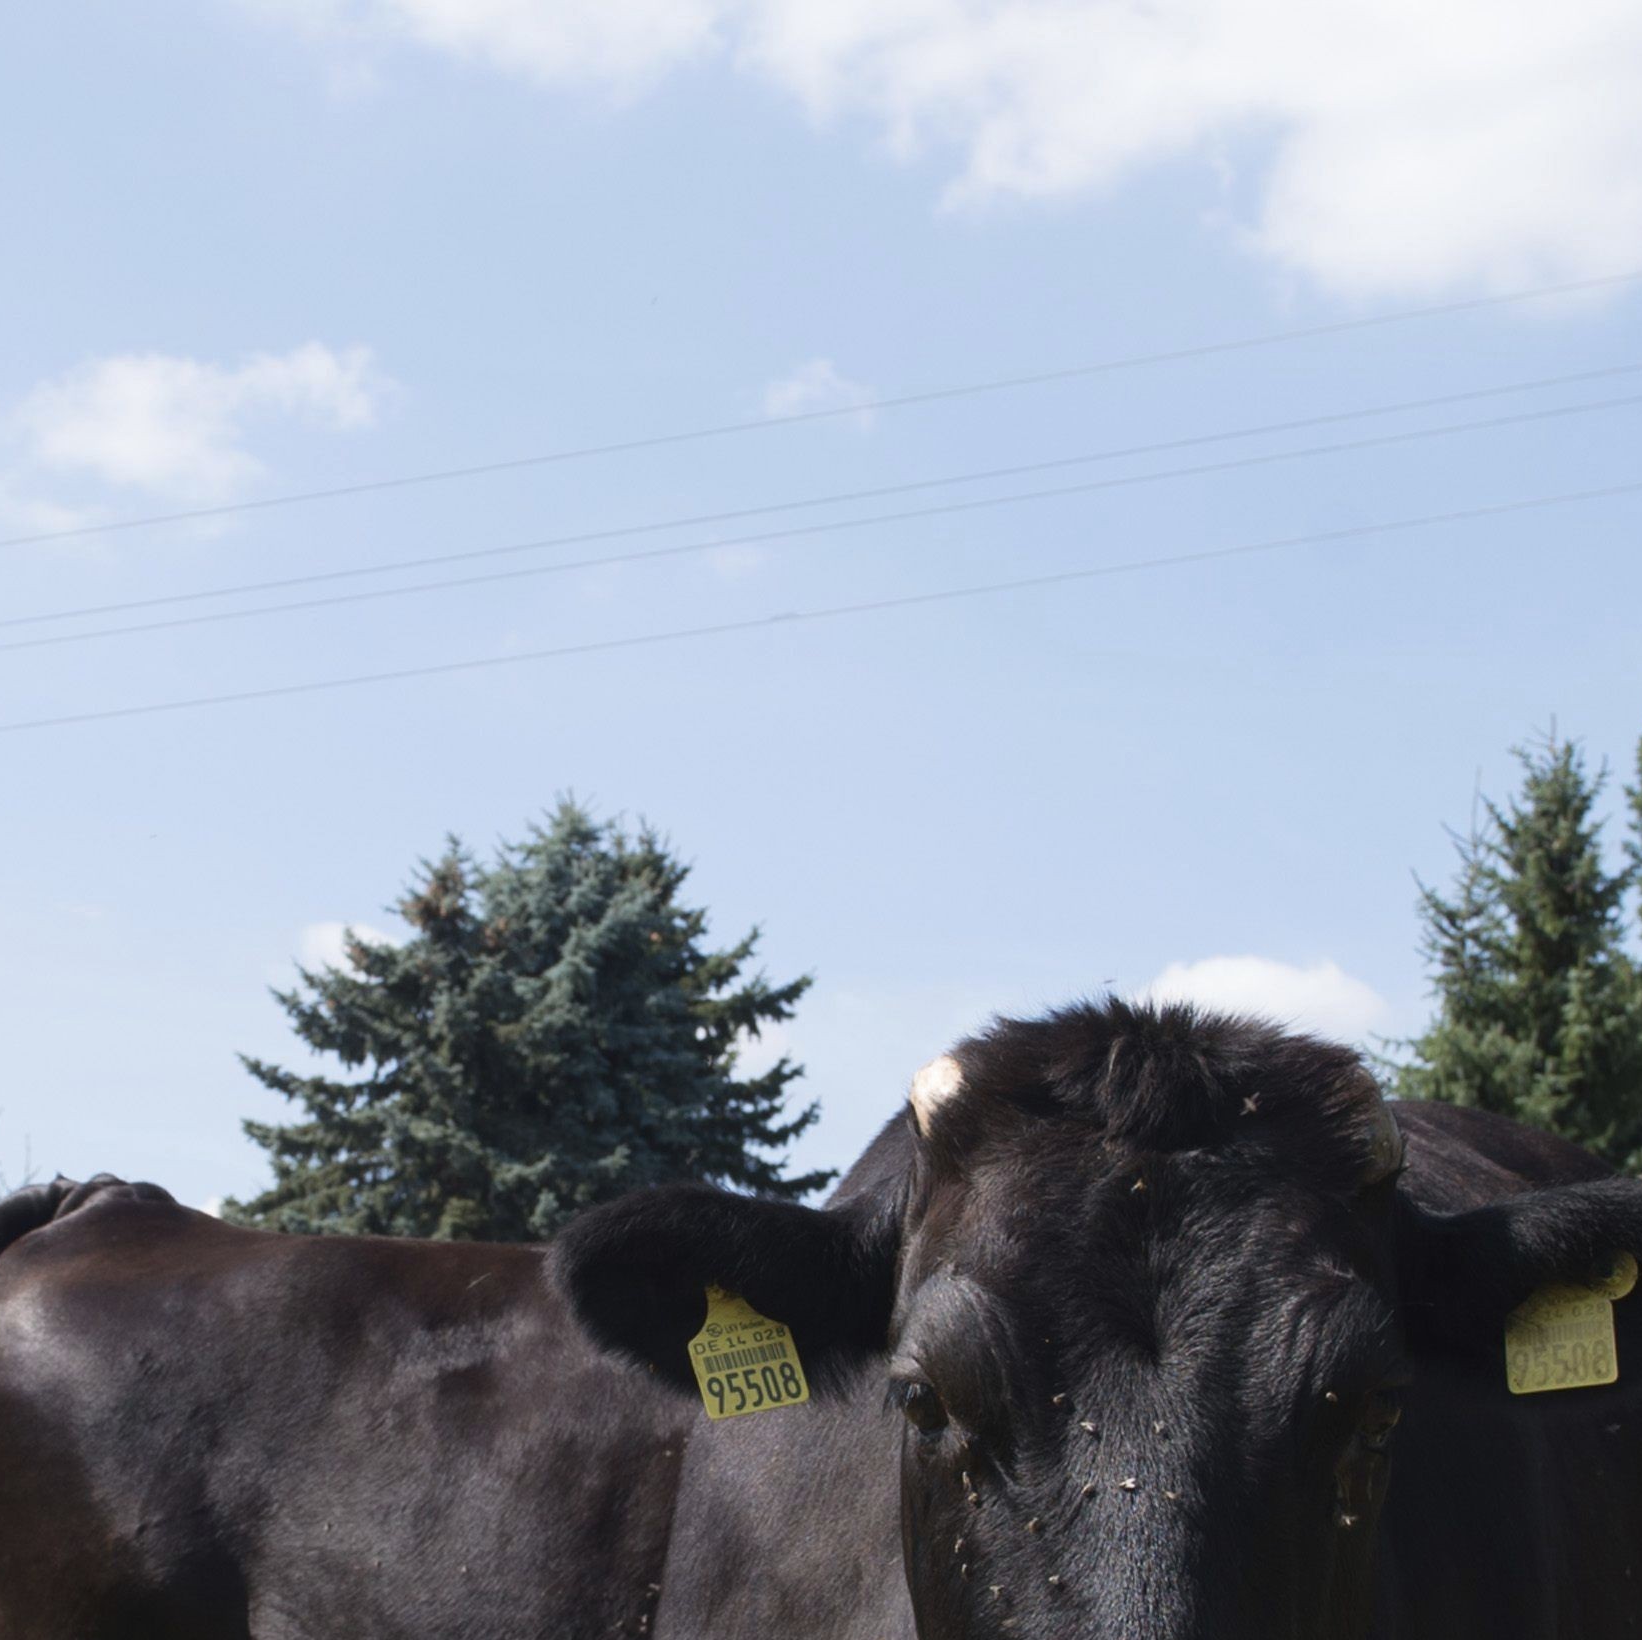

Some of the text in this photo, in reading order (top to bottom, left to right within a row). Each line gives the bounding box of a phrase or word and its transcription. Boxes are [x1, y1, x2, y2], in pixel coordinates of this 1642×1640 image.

[693, 1340, 721, 1356] DE
[1512, 1339, 1610, 1389] 95508
[707, 1362, 802, 1415] 95508
